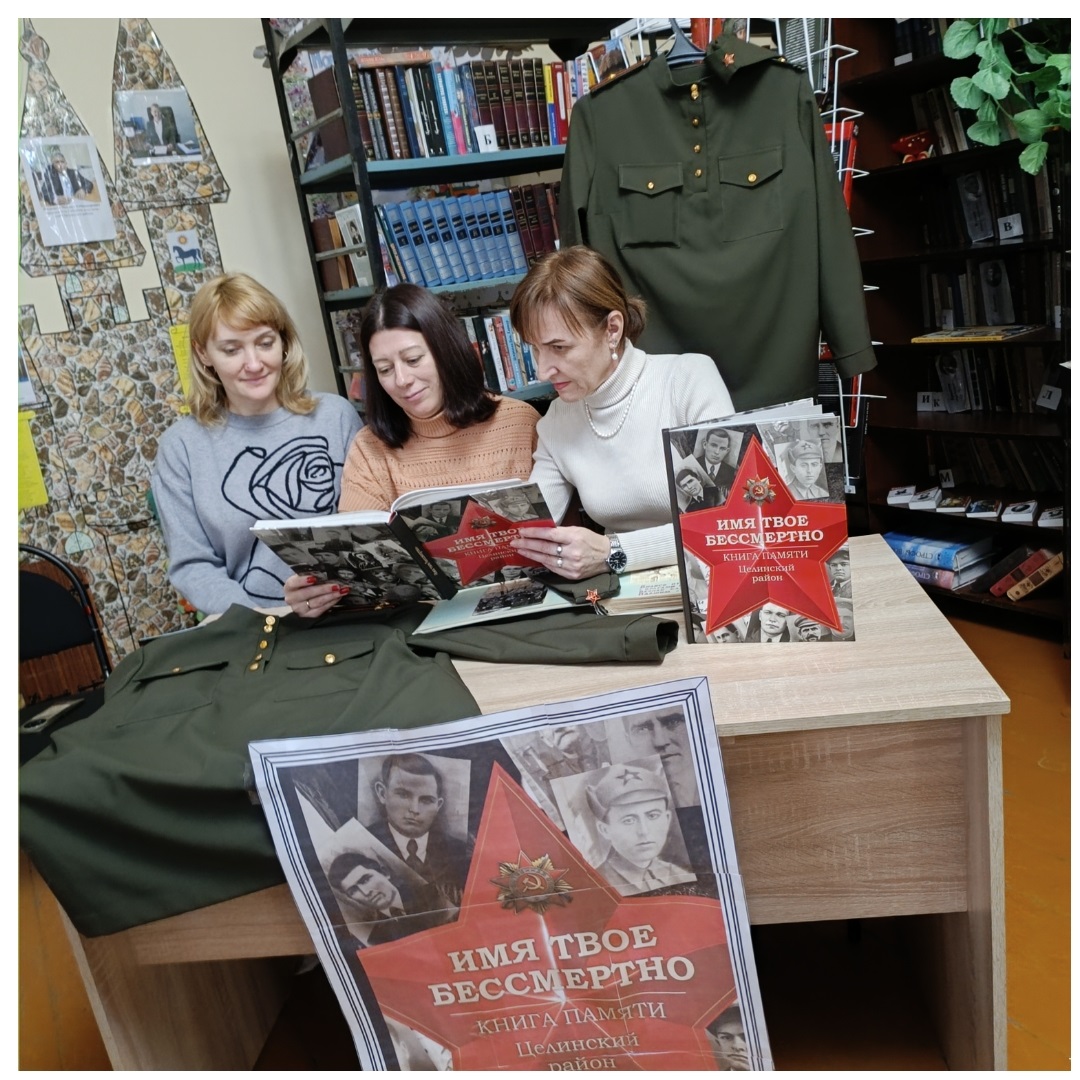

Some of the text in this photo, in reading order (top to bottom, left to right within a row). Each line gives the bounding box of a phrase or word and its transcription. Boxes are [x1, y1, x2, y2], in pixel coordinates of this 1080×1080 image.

[484, 135, 492, 145] Б
[1003, 222, 1013, 232] В
[922, 394, 930, 404] И
[1042, 390, 1052, 400] Л
[933, 398, 941, 408] К
[939, 472, 951, 484] М
[716, 515, 809, 530] ИМЯ ТВОЕ
[454, 526, 522, 546] ИМЯ ТВО
[706, 529, 824, 546] БЕССМЕРТНО
[447, 534, 522, 553] БЕССМЕРТ
[723, 550, 809, 562] КНИГА ПАМЯТИ
[738, 564, 795, 574] Целинский
[752, 574, 783, 584] район
[447, 924, 658, 973] ИМЯ ТВОЕ
[428, 956, 696, 1006] БЕССМЕРТНО
[477, 1002, 666, 1035] КНИГА ПАМЯТИ
[516, 1032, 640, 1058] Целинский
[548, 1056, 617, 1071] район
